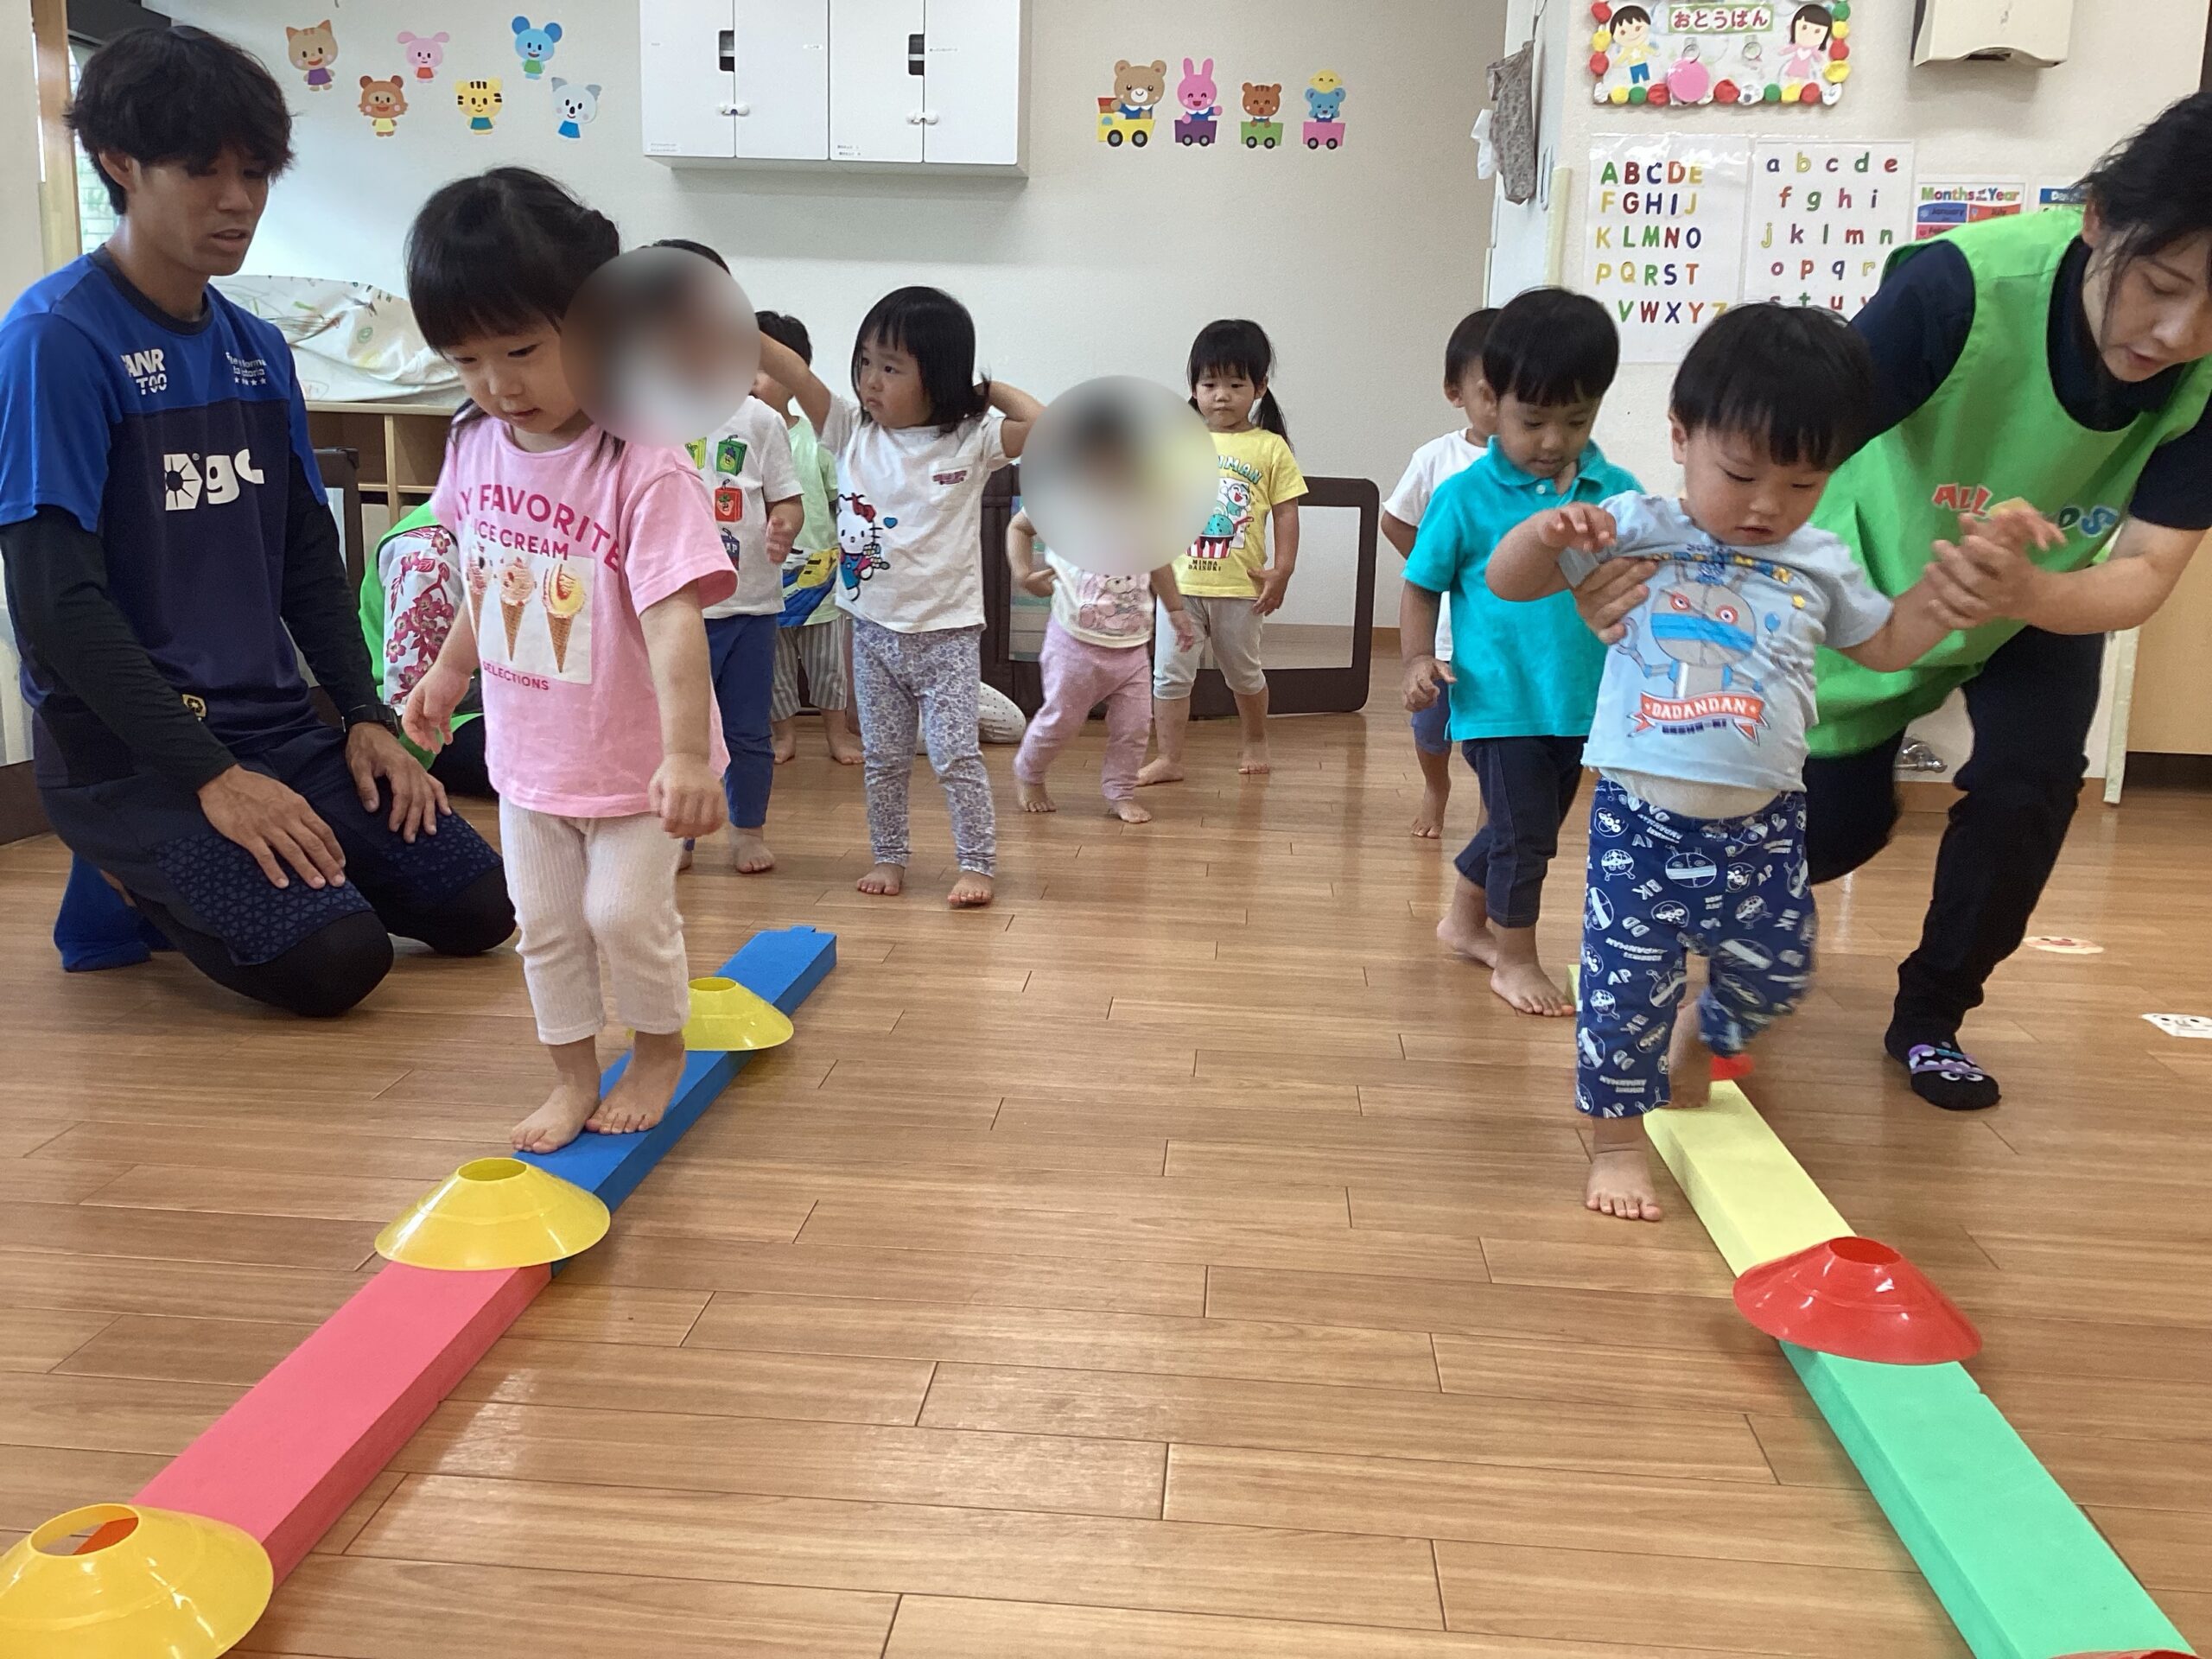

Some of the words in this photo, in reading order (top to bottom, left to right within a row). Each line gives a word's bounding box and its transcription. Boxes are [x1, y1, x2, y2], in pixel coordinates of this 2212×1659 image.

[1673, 11, 1768, 29] おとうばん
[1766, 158, 1780, 173] a
[1796, 152, 1811, 173] b
[1826, 158, 1839, 173] c
[1854, 152, 1870, 173] d
[1884, 158, 1898, 173] e
[1778, 186, 1793, 208] f
[1807, 191, 1821, 212] g
[1838, 188, 1852, 208] h
[1870, 188, 1878, 208] i
[1921, 186, 1974, 200] Months
[1988, 187, 2020, 200] Year
[1761, 222, 1773, 248] j
[1790, 223, 1804, 244] k
[1845, 228, 1864, 245] m
[1879, 228, 1893, 245] n
[1770, 262, 1784, 276] o
[1800, 259, 1814, 280] p
[1832, 259, 1846, 280] q
[1862, 261, 1876, 276] r
[1830, 296, 1844, 311] u
[1931, 482, 1993, 518] ALL
[474, 518, 497, 543] ICE
[500, 530, 569, 561] CREAM
[480, 484, 620, 573] FAVORITE
[483, 662, 550, 690] SELECTIONS
[1651, 697, 1747, 720] DADANDAN
[1607, 969, 1631, 985] AP
